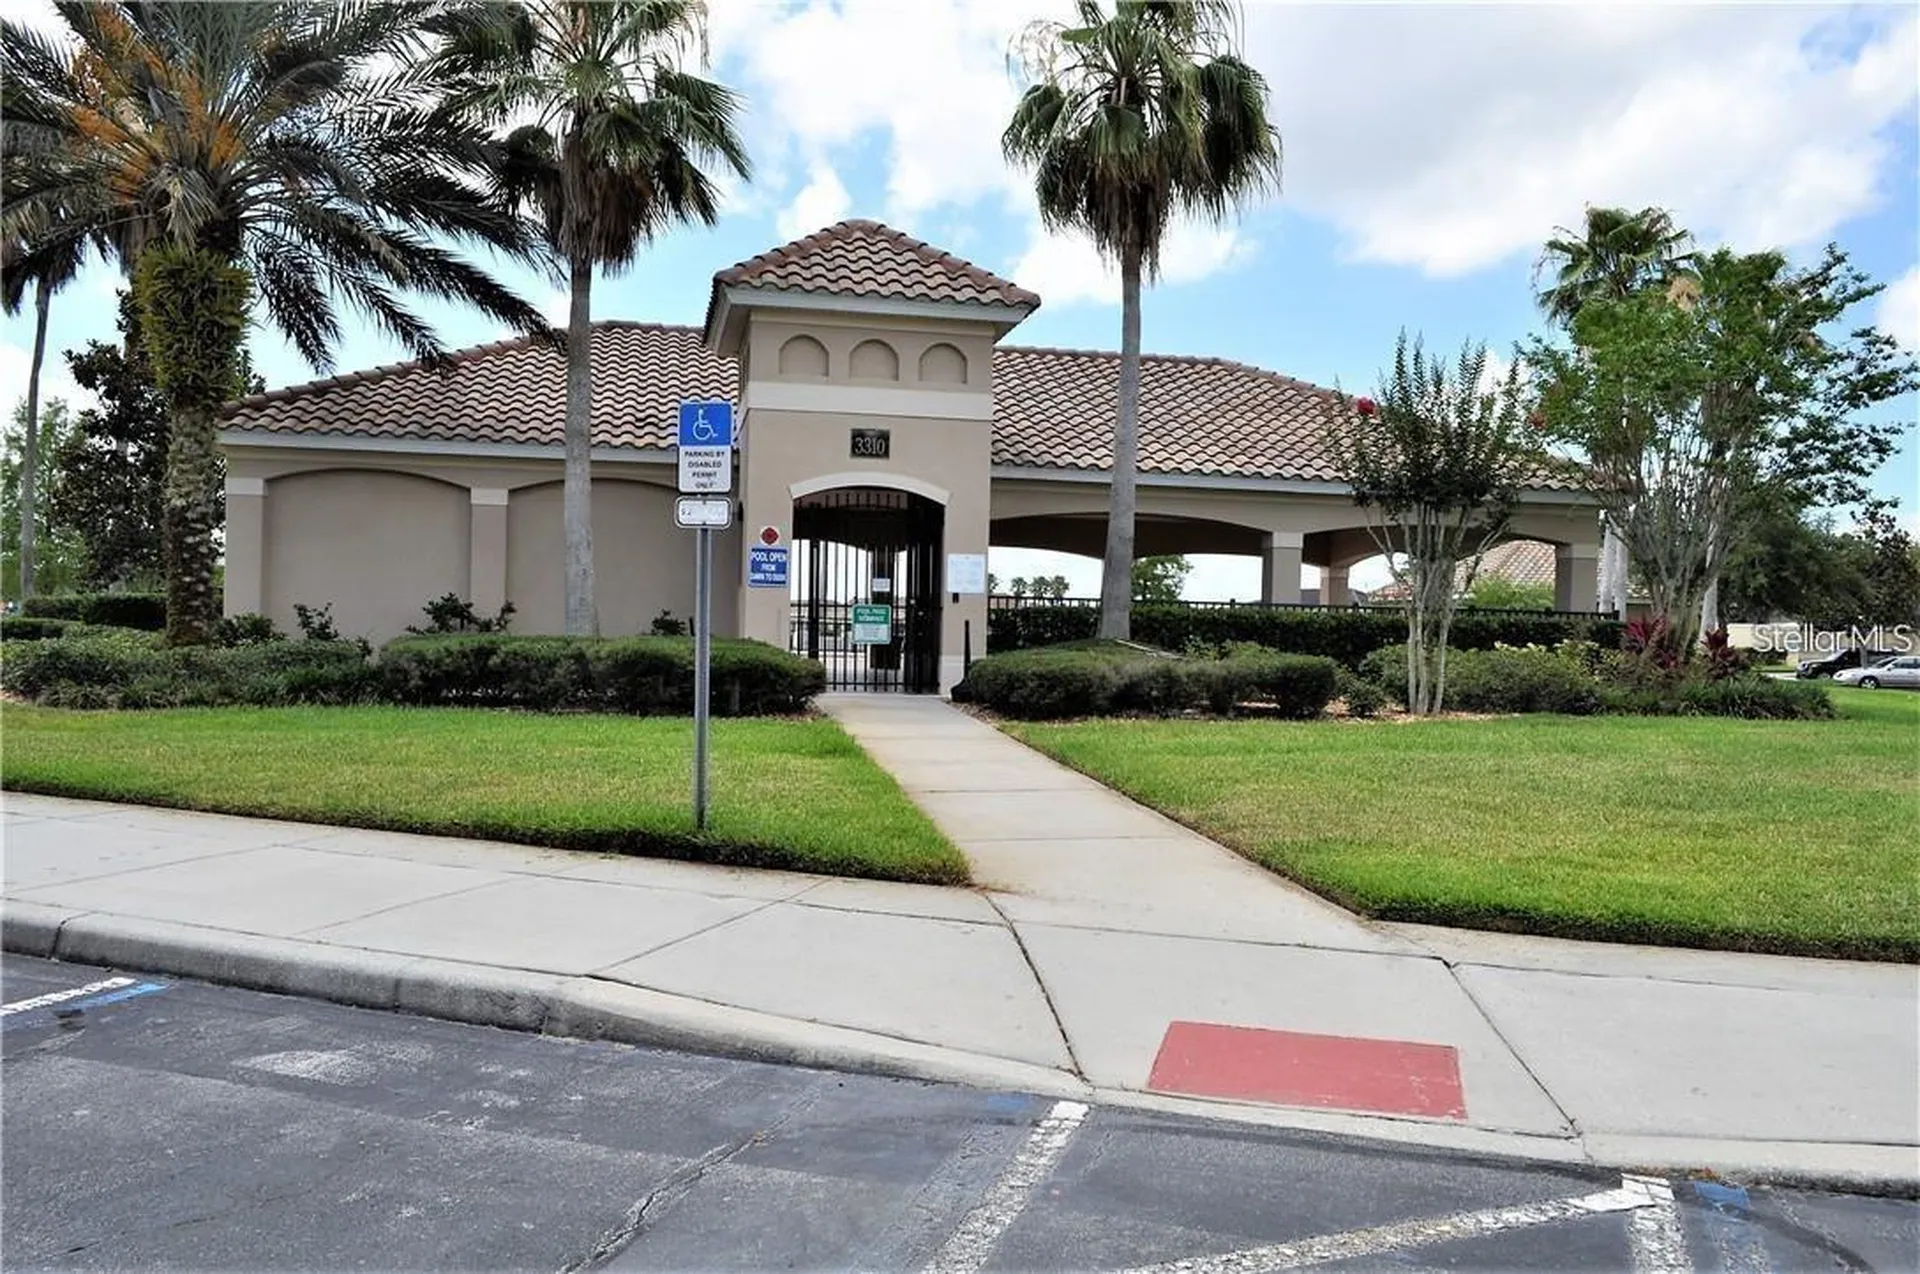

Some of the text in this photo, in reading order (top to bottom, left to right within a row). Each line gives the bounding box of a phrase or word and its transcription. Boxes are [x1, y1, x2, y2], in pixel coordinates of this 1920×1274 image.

[855, 436, 886, 454] 3310
[751, 551, 786, 562] POOL OPEN
